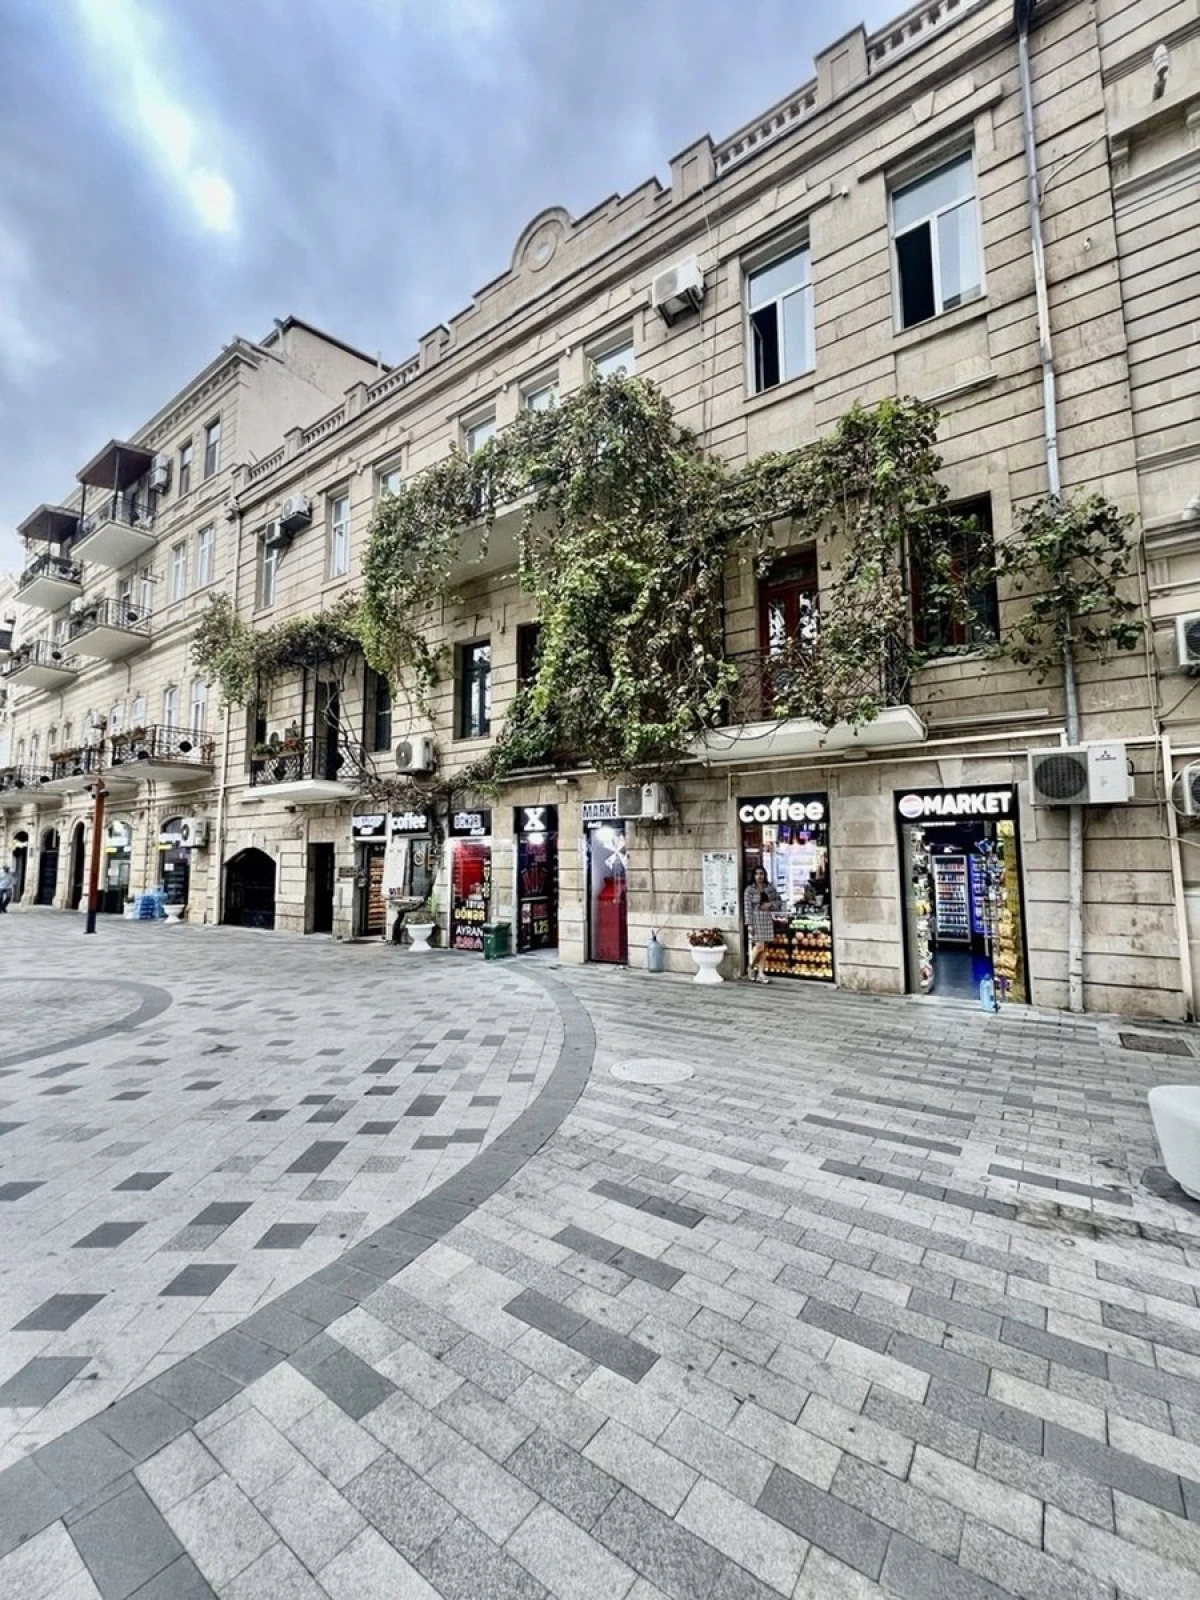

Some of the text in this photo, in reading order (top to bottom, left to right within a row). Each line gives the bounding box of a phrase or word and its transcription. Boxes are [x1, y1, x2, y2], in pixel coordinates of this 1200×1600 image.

[583, 803, 616, 818] MARKE
[739, 797, 824, 823] coffee
[923, 791, 1012, 816] MARKET
[391, 812, 427, 829] coffee
[523, 807, 546, 831] X
[455, 925, 484, 937] AYRAN
